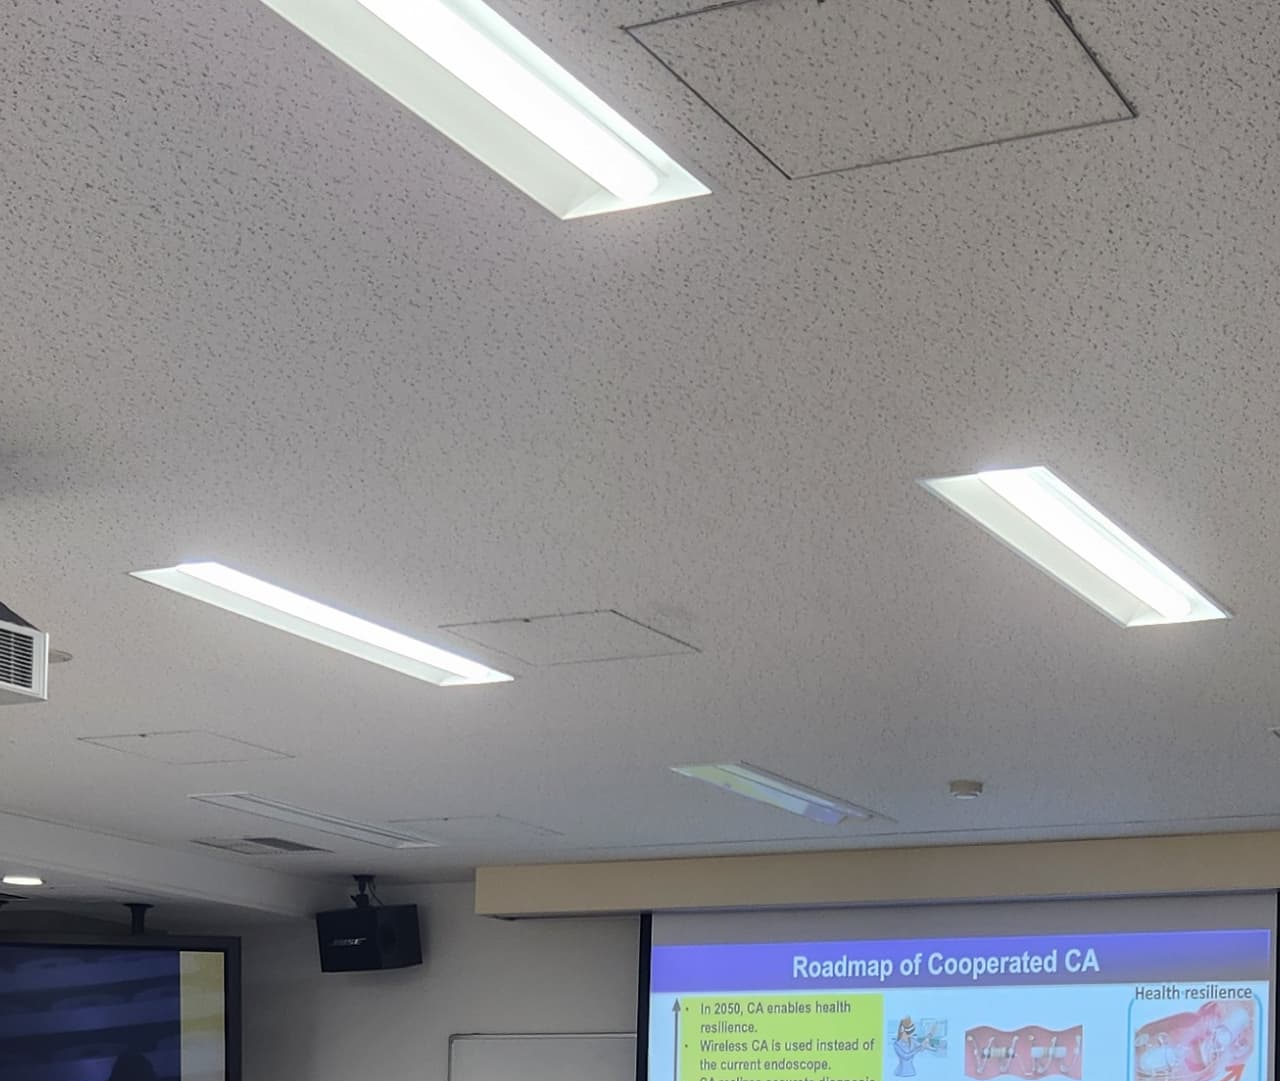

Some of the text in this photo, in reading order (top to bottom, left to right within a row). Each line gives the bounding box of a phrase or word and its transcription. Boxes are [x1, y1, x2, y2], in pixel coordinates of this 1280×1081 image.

[793, 948, 1100, 981] Roadmap of Cooperated CA
[1135, 984, 1252, 1000] Health resilience
[700, 1000, 851, 1016] In 2050, CA enables health
[700, 1020, 758, 1033] resilience.
[700, 1038, 875, 1052] Wireless CA is used instead of
[699, 1058, 831, 1072] the current endoscope.
